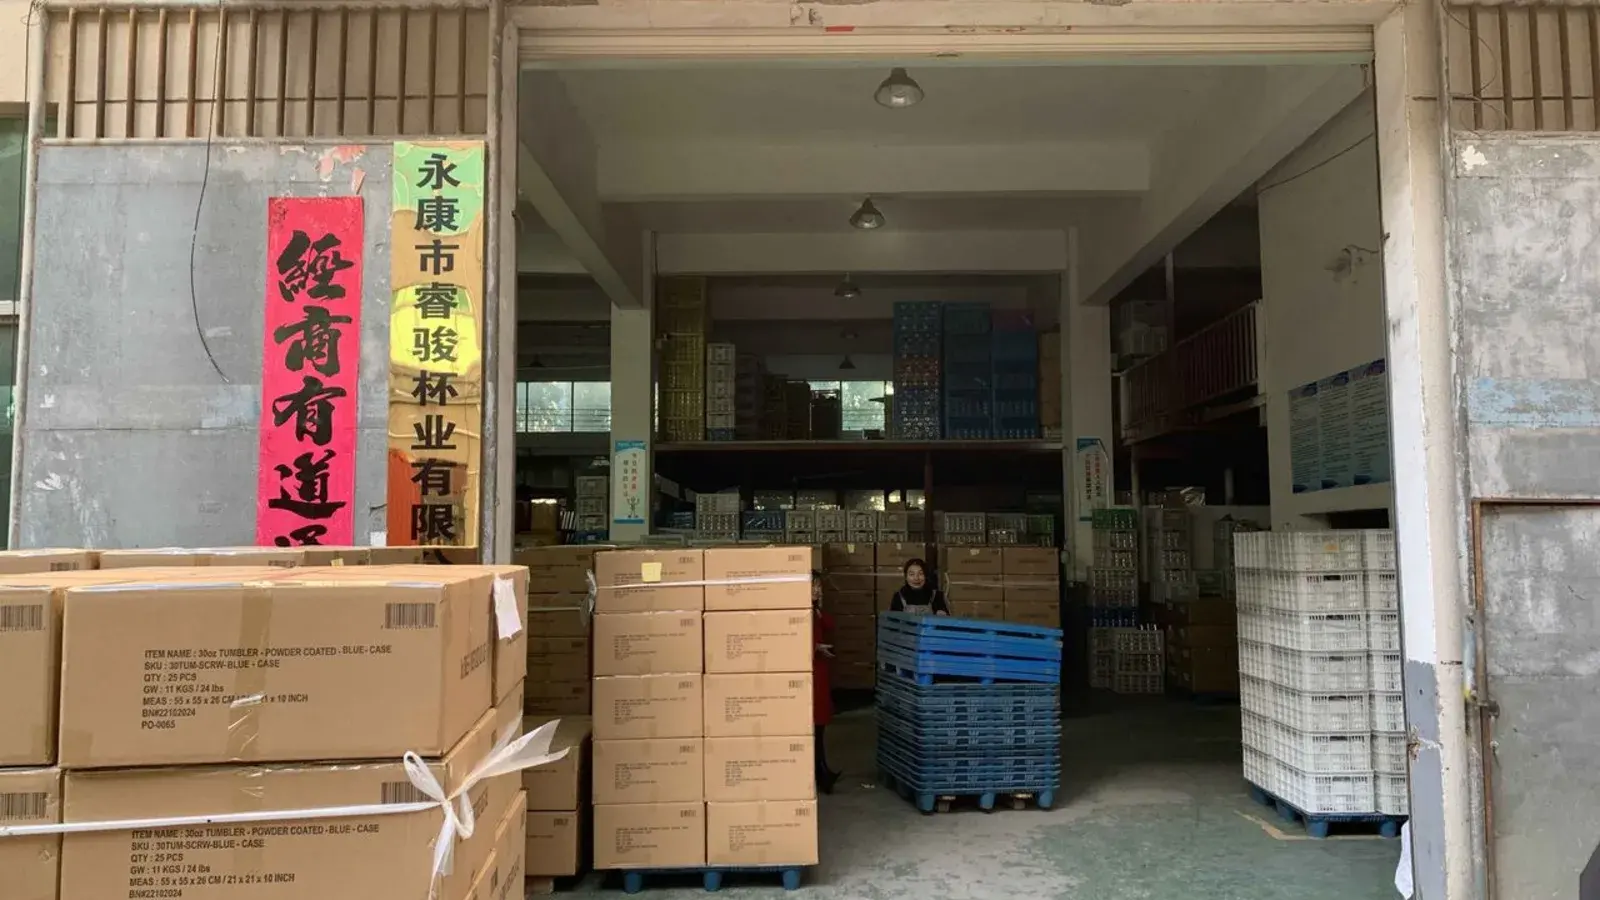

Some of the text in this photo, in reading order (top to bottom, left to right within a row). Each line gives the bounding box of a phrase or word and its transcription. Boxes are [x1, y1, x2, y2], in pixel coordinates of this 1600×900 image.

[144, 650, 165, 658] ITEM
[167, 649, 192, 658] NAME
[198, 649, 217, 658] 30oz
[220, 648, 258, 657] TUMBLER
[265, 648, 301, 657] POWDER
[303, 647, 337, 656] COATED
[342, 645, 364, 654] BLUE
[370, 645, 392, 654] CASE
[144, 662, 162, 670] SKU
[257, 659, 280, 668] CASE
[144, 674, 160, 682] QTY
[168, 674, 178, 682] 25
[180, 673, 197, 681] PCS
[143, 685, 158, 694] GW
[165, 685, 174, 693] 11
[176, 685, 194, 693] KGS
[196, 684, 199, 692] /
[200, 684, 210, 692] 24
[143, 697, 167, 706] MEAS
[174, 696, 184, 705] 55
[192, 696, 202, 704] 55
[210, 696, 220, 704] 26
[277, 695, 286, 703] 10
[288, 693, 308, 703] INCH
[142, 720, 175, 729] PO-0065
[132, 830, 152, 839] ITEM
[154, 829, 178, 838] NAME
[185, 829, 204, 838] 30oz
[206, 828, 246, 837] TUMBLER
[251, 826, 288, 836] POWDER
[290, 826, 323, 835] COATED
[329, 825, 350, 834] BLUE
[357, 824, 379, 833] CASE
[131, 842, 149, 850] SKU
[242, 839, 264, 848] CASE
[131, 854, 148, 863] QTY
[154, 854, 165, 862] 25
[166, 853, 184, 861] PCS
[130, 866, 145, 875] GW
[162, 865, 180, 873] KGS
[182, 865, 185, 873] /
[187, 865, 196, 873] 24
[130, 878, 154, 886] MEAS
[160, 877, 170, 885] 55
[179, 877, 188, 885] 55
[208, 876, 220, 884] CM
[222, 875, 226, 884] /
[227, 875, 236, 884] 21
[245, 875, 254, 883] 21
[264, 874, 273, 883] 10
[274, 873, 295, 882] INCH
